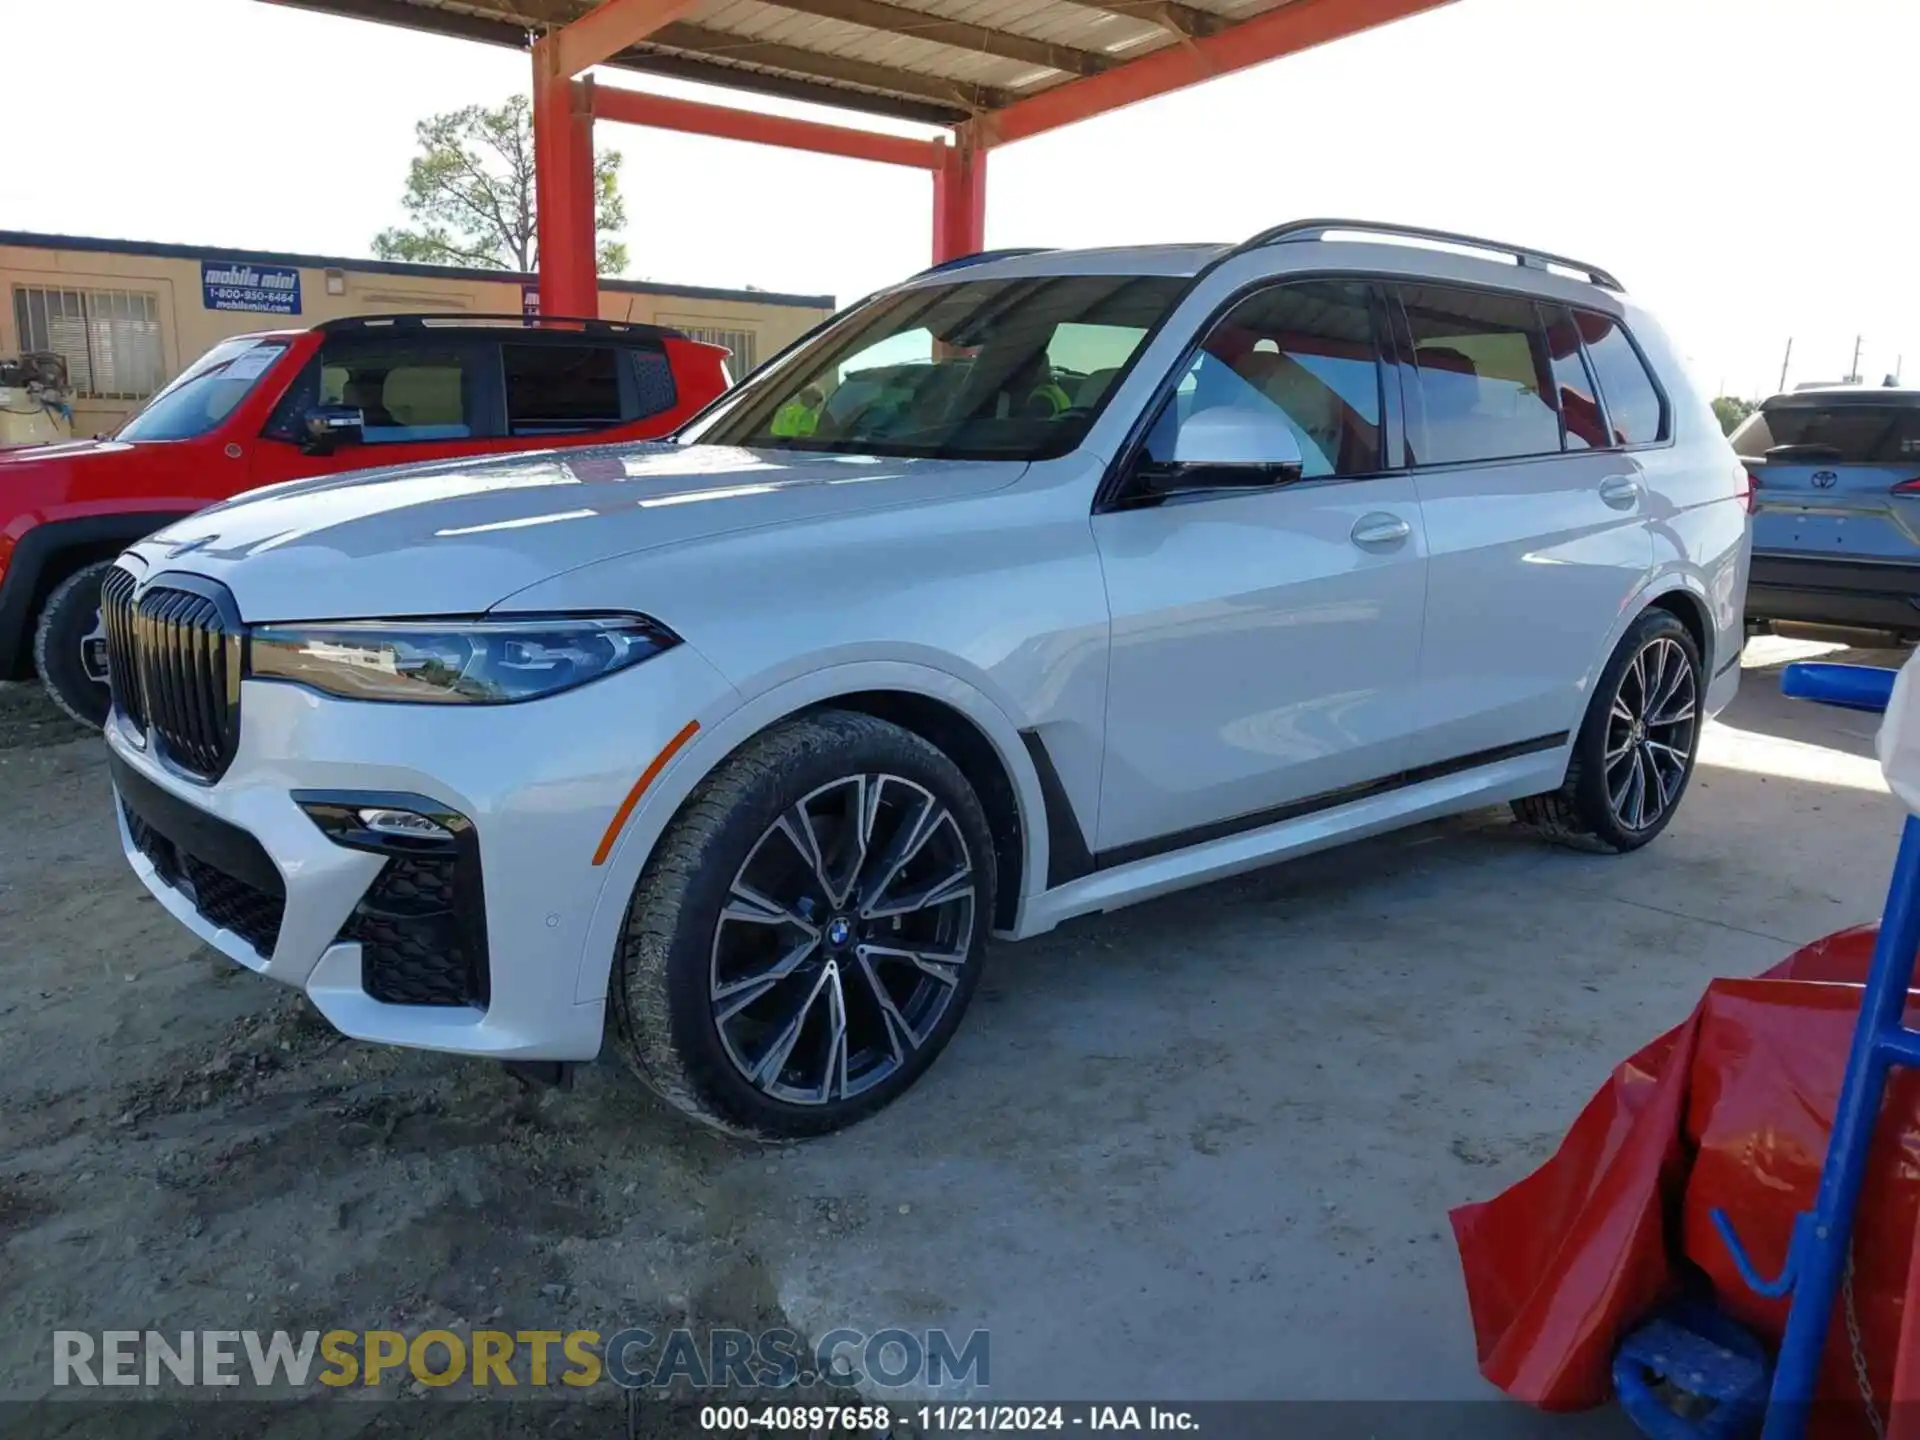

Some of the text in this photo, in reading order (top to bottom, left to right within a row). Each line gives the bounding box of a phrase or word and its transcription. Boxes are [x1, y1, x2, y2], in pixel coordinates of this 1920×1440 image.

[205, 266, 296, 288] mobile mini
[216, 300, 291, 312] mobilemini.com
